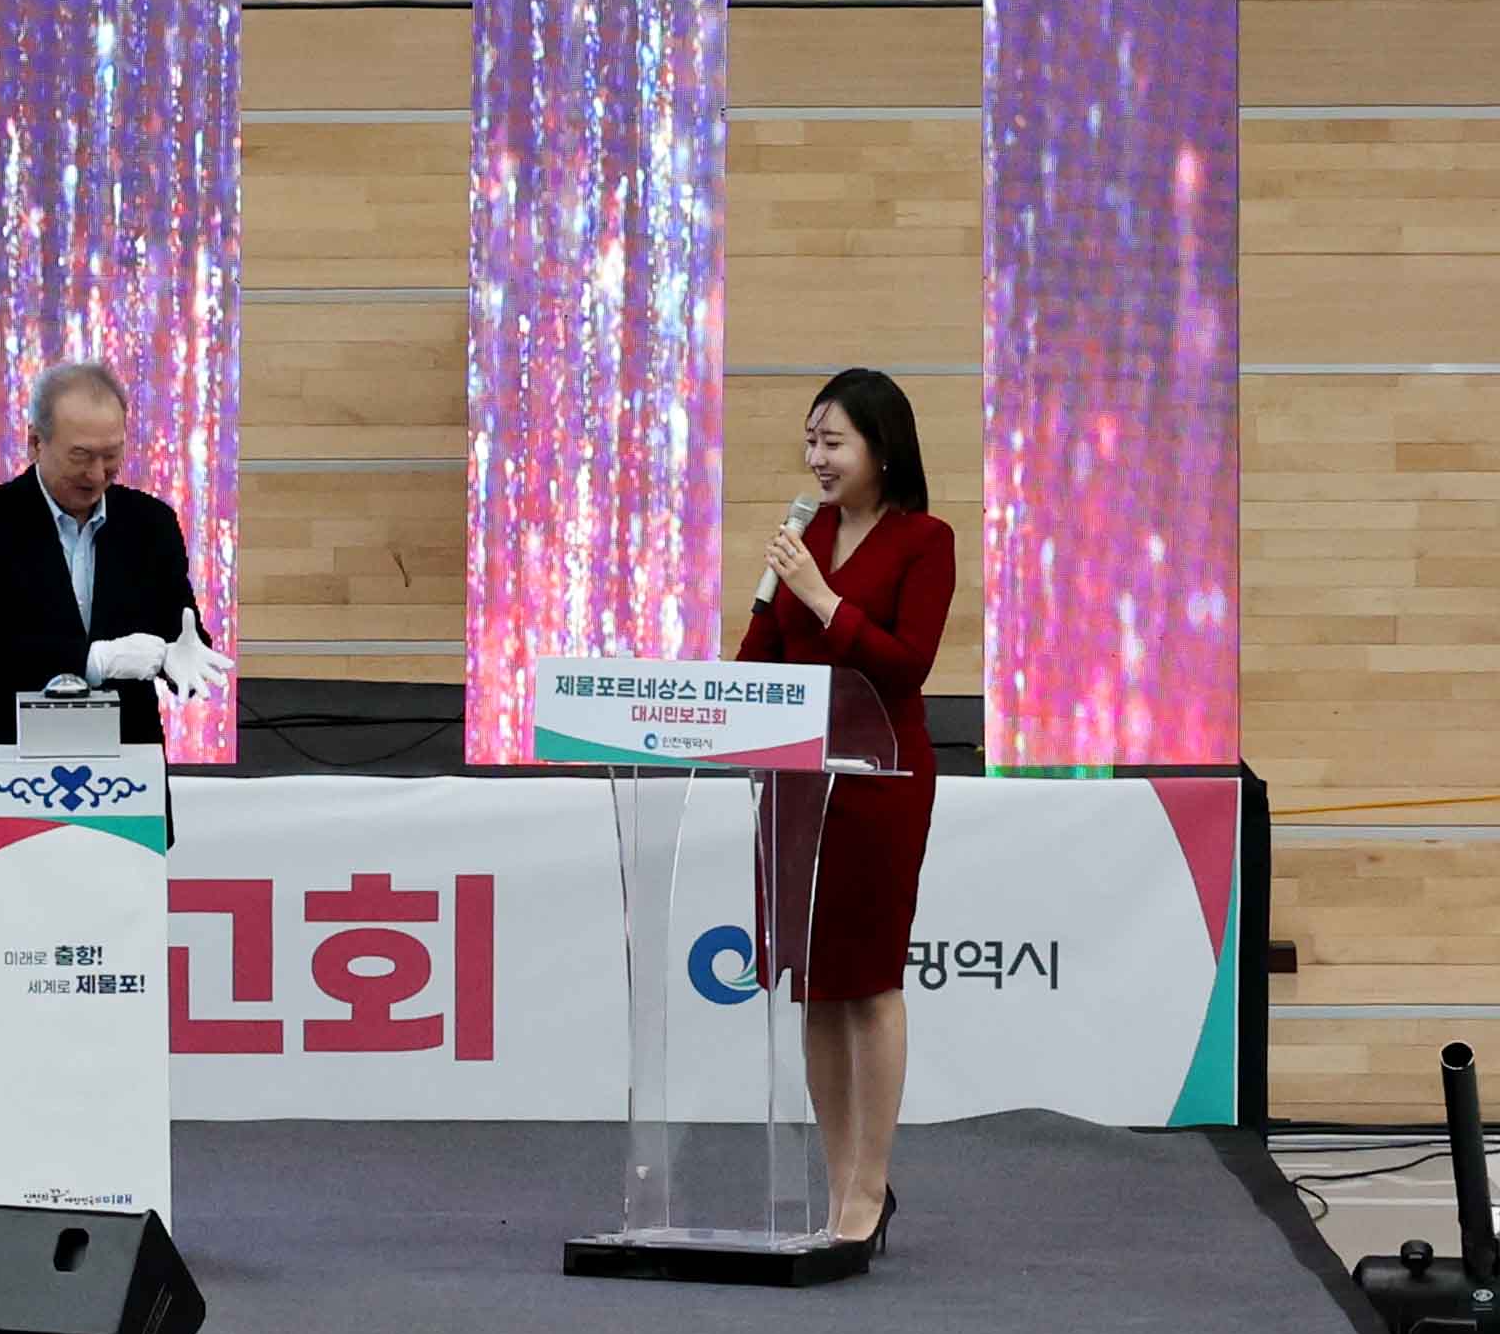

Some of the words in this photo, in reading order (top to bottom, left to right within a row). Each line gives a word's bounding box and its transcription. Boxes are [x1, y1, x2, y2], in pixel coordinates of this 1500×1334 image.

[555, 675, 697, 701] 제물포르네상스
[704, 680, 805, 705] 마스터플랜
[632, 706, 727, 725] 대시민보고회
[661, 736, 713, 749] 인천광역시
[4, 951, 47, 965] 미래로
[55, 946, 103, 966] 출항!
[28, 980, 70, 994] 세계로
[76, 975, 145, 994] 제물포!
